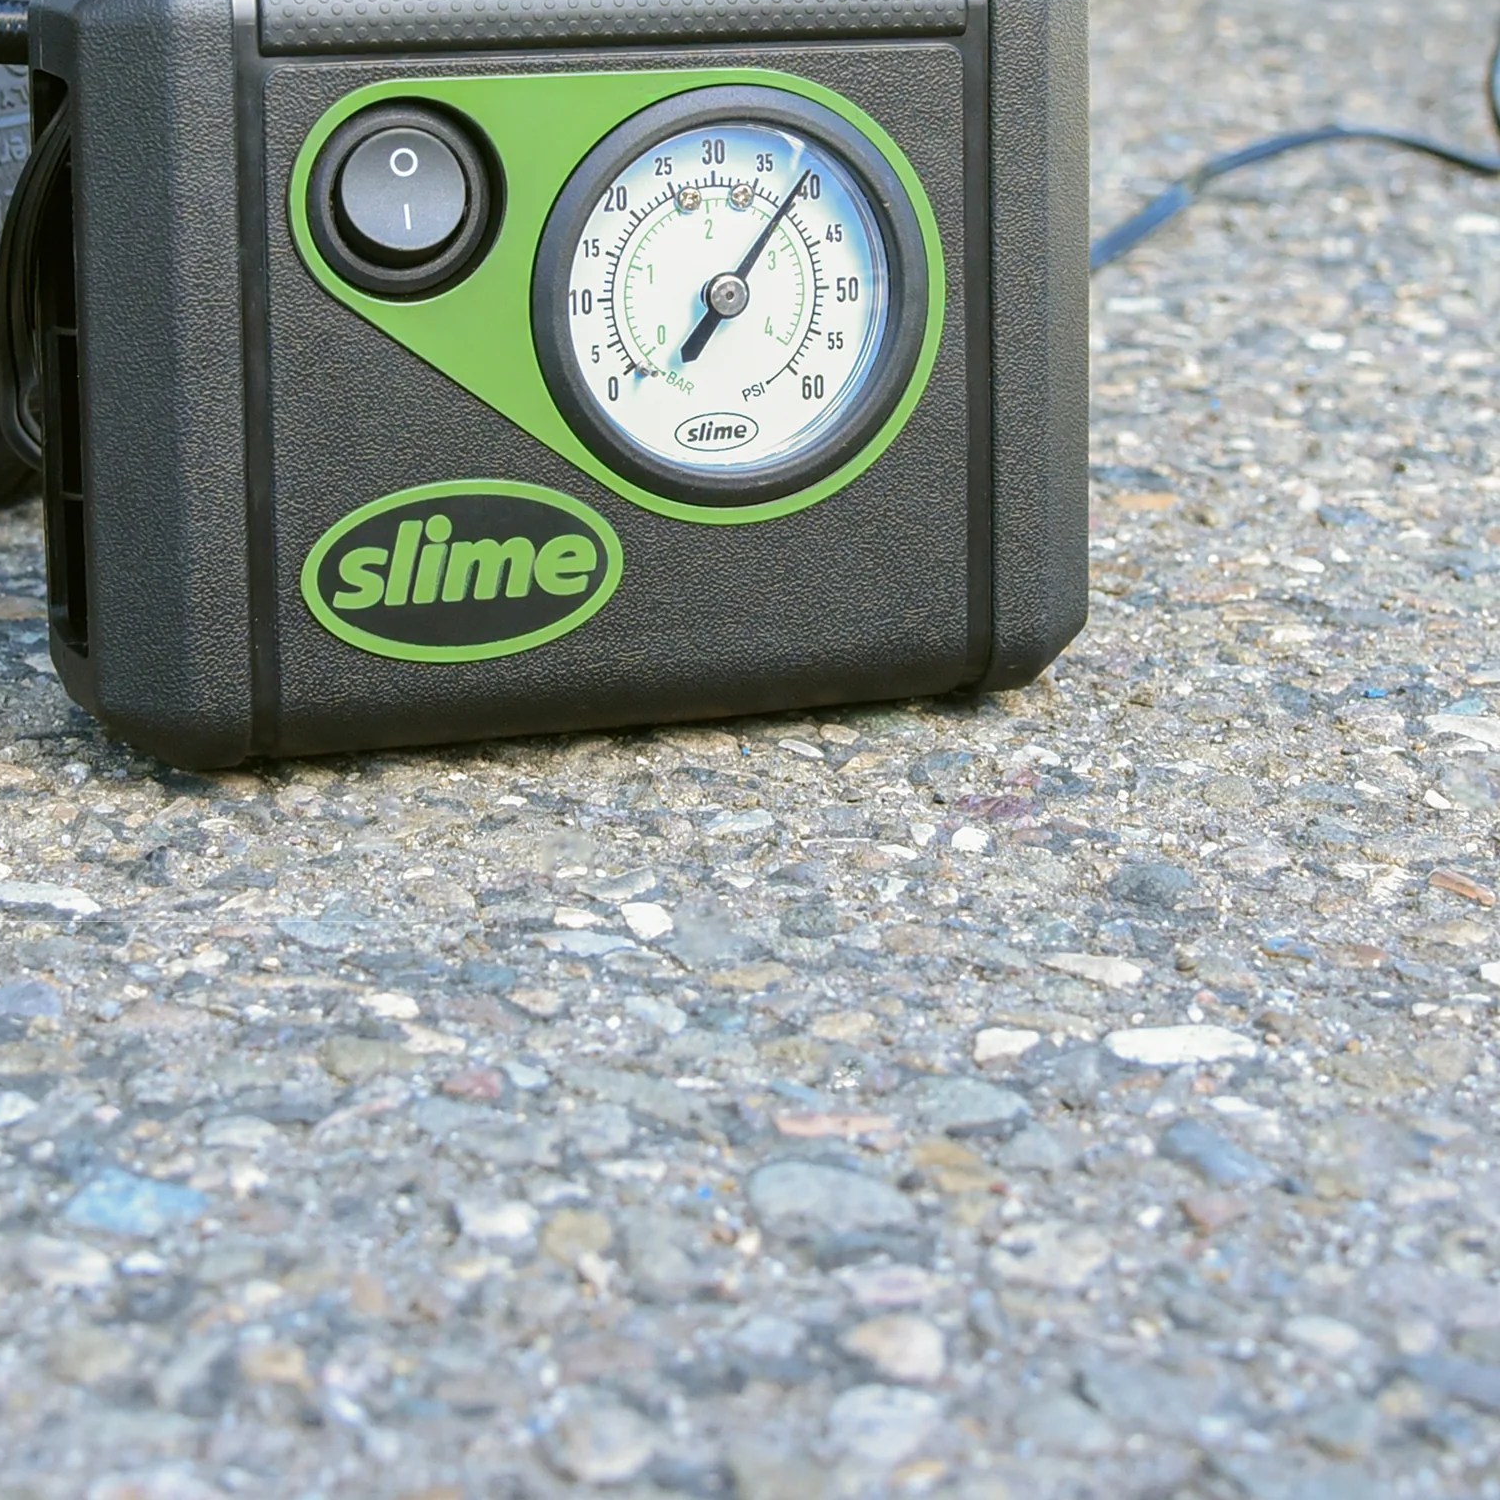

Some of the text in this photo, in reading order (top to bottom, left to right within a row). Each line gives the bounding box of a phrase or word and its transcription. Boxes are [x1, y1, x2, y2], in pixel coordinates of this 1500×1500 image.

[702, 140, 725, 165] 30
[756, 153, 773, 172] 35
[654, 157, 673, 176] 25
[798, 174, 821, 200] 40
[604, 187, 628, 212] 20
[704, 219, 713, 240] 2
[825, 224, 843, 243] 45
[583, 240, 600, 258] 15
[767, 250, 777, 270] 3
[647, 264, 654, 284] 1
[836, 277, 859, 302] 50
[569, 288, 593, 315] 10
[656, 325, 666, 346] 0
[764, 316, 773, 336] 4
[827, 332, 844, 350] 55
[591, 345, 600, 363] 5
[607, 376, 619, 401] 0
[665, 370, 695, 396] BAR
[741, 381, 766, 402] PSI
[801, 375, 824, 400] 60
[687, 419, 748, 443] slime
[332, 514, 597, 610] slime
